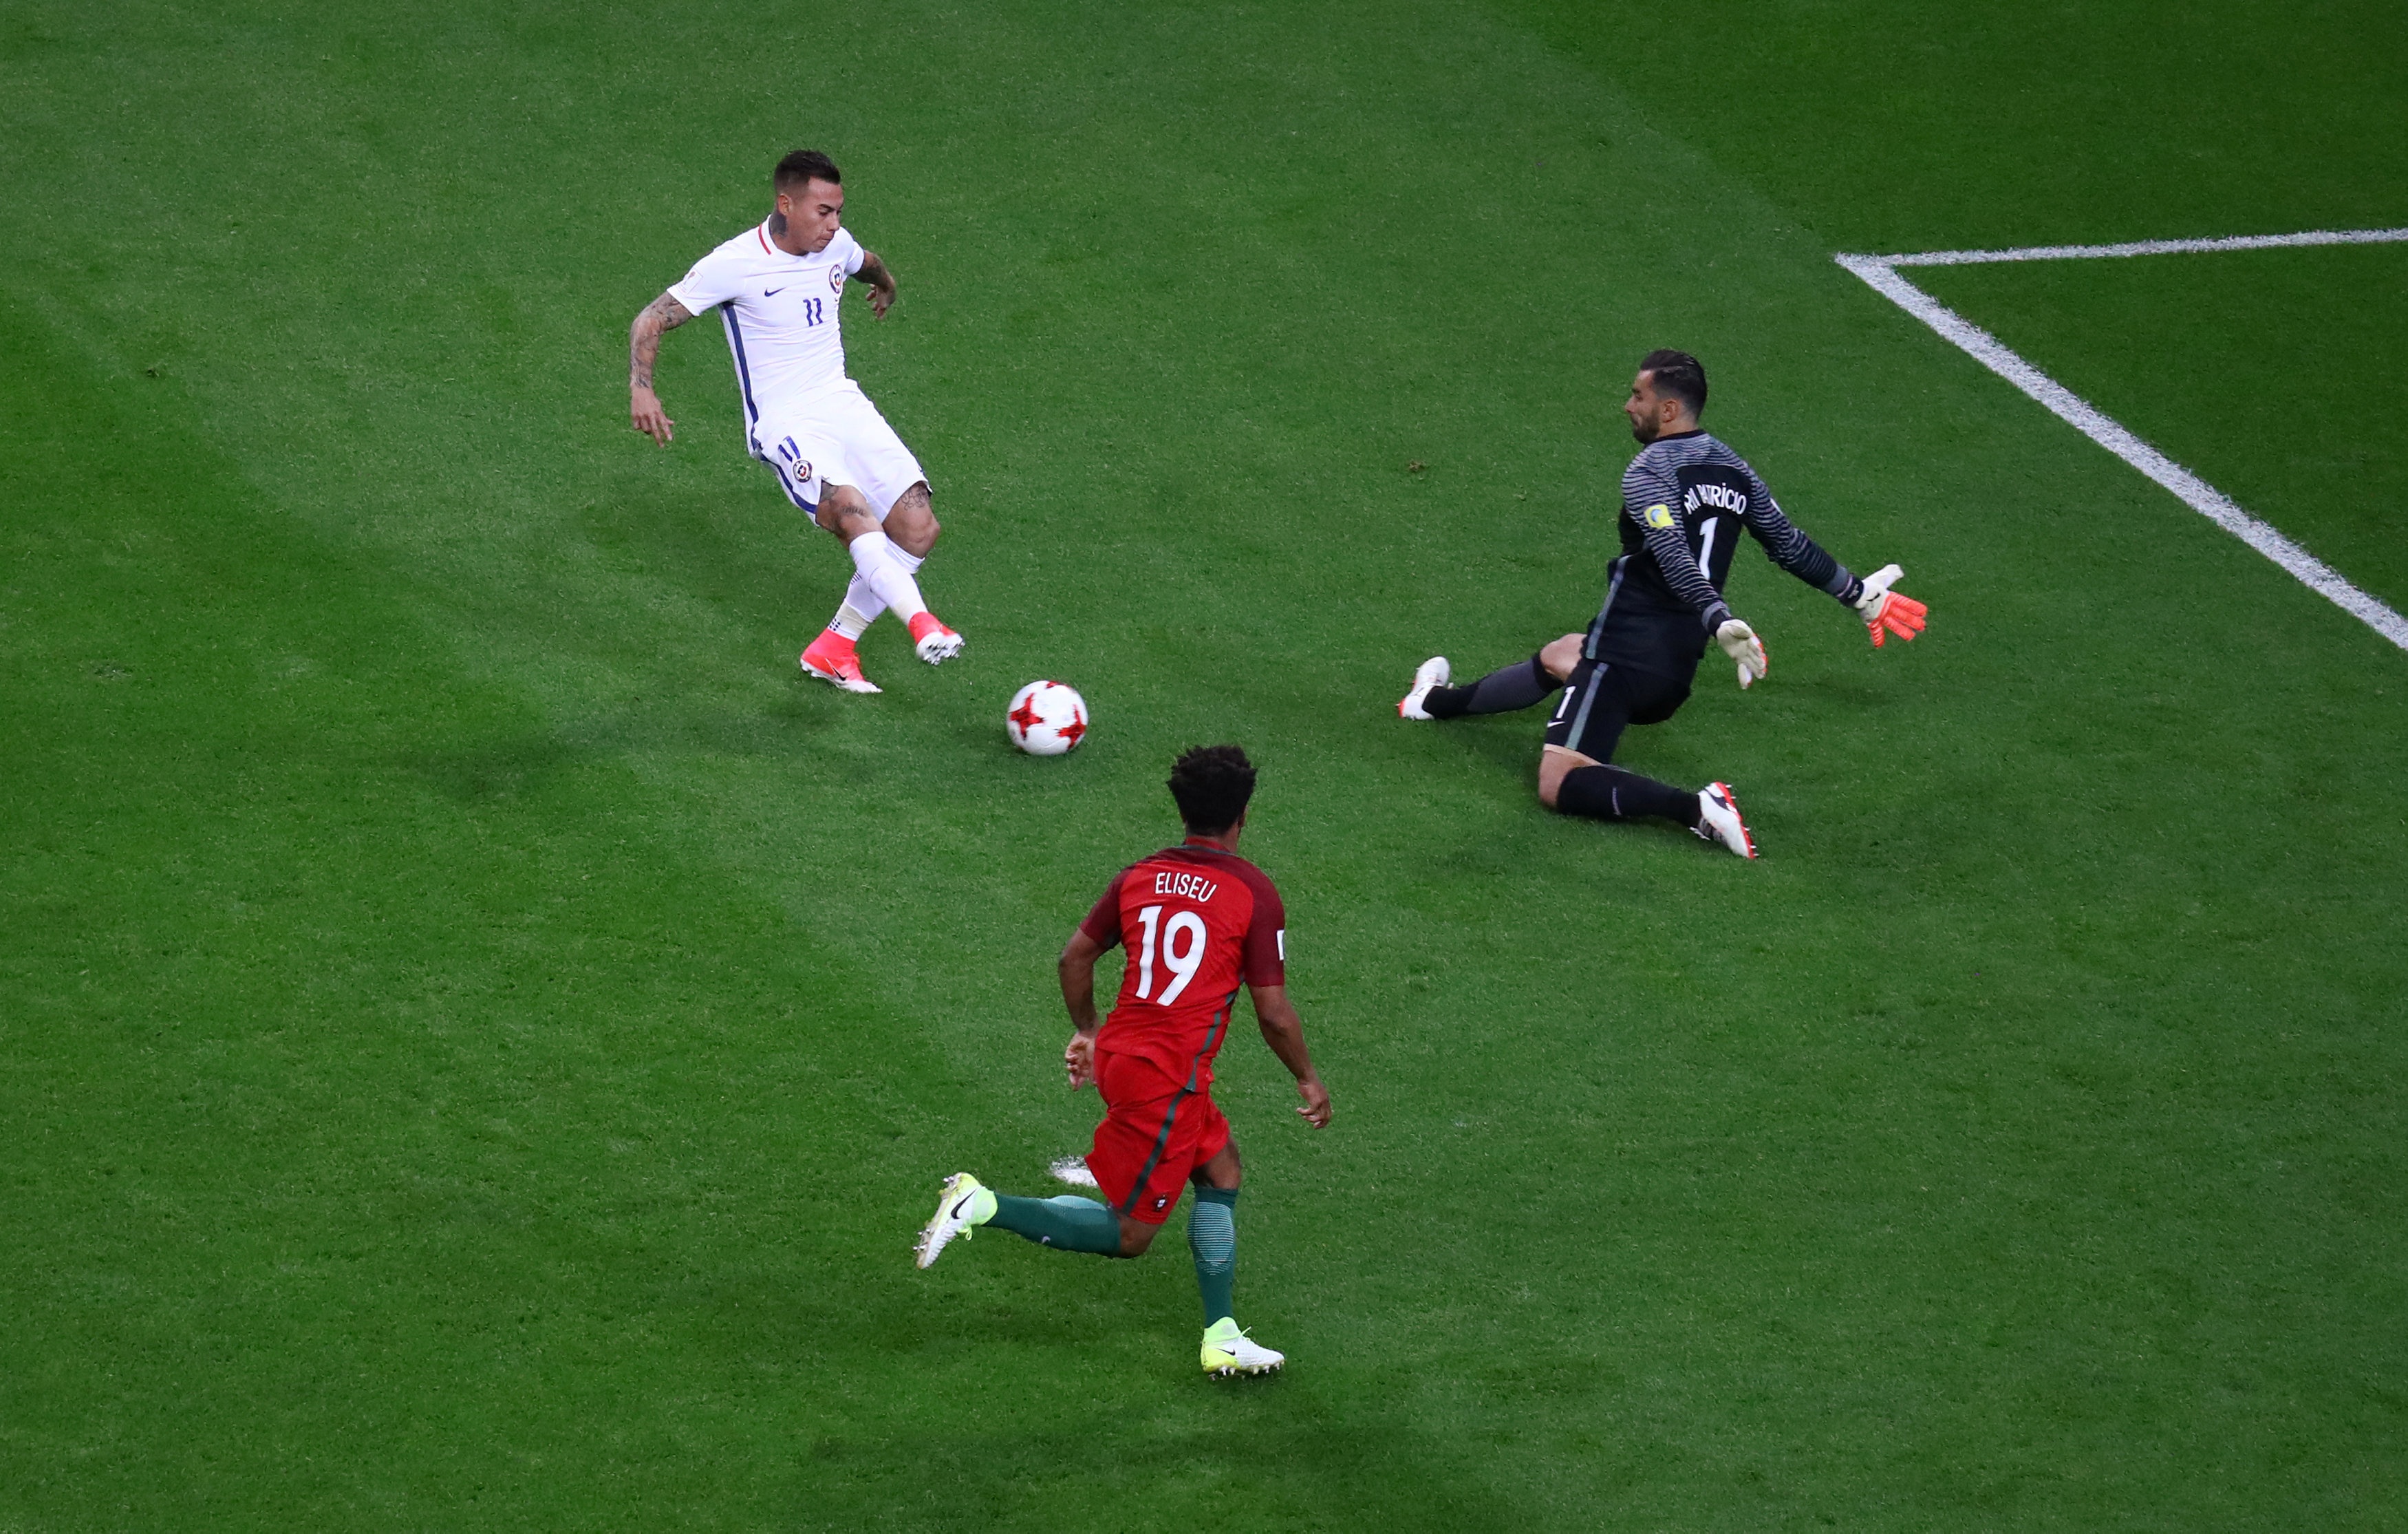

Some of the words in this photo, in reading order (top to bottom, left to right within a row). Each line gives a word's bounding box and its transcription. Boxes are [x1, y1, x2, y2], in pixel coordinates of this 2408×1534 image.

[803, 297, 824, 327] 11
[778, 435, 802, 463] 11
[1698, 517, 1718, 581] 1
[1556, 685, 1576, 719] 1
[1154, 872, 1218, 903] ELISEU
[1135, 905, 1207, 1007] 19
